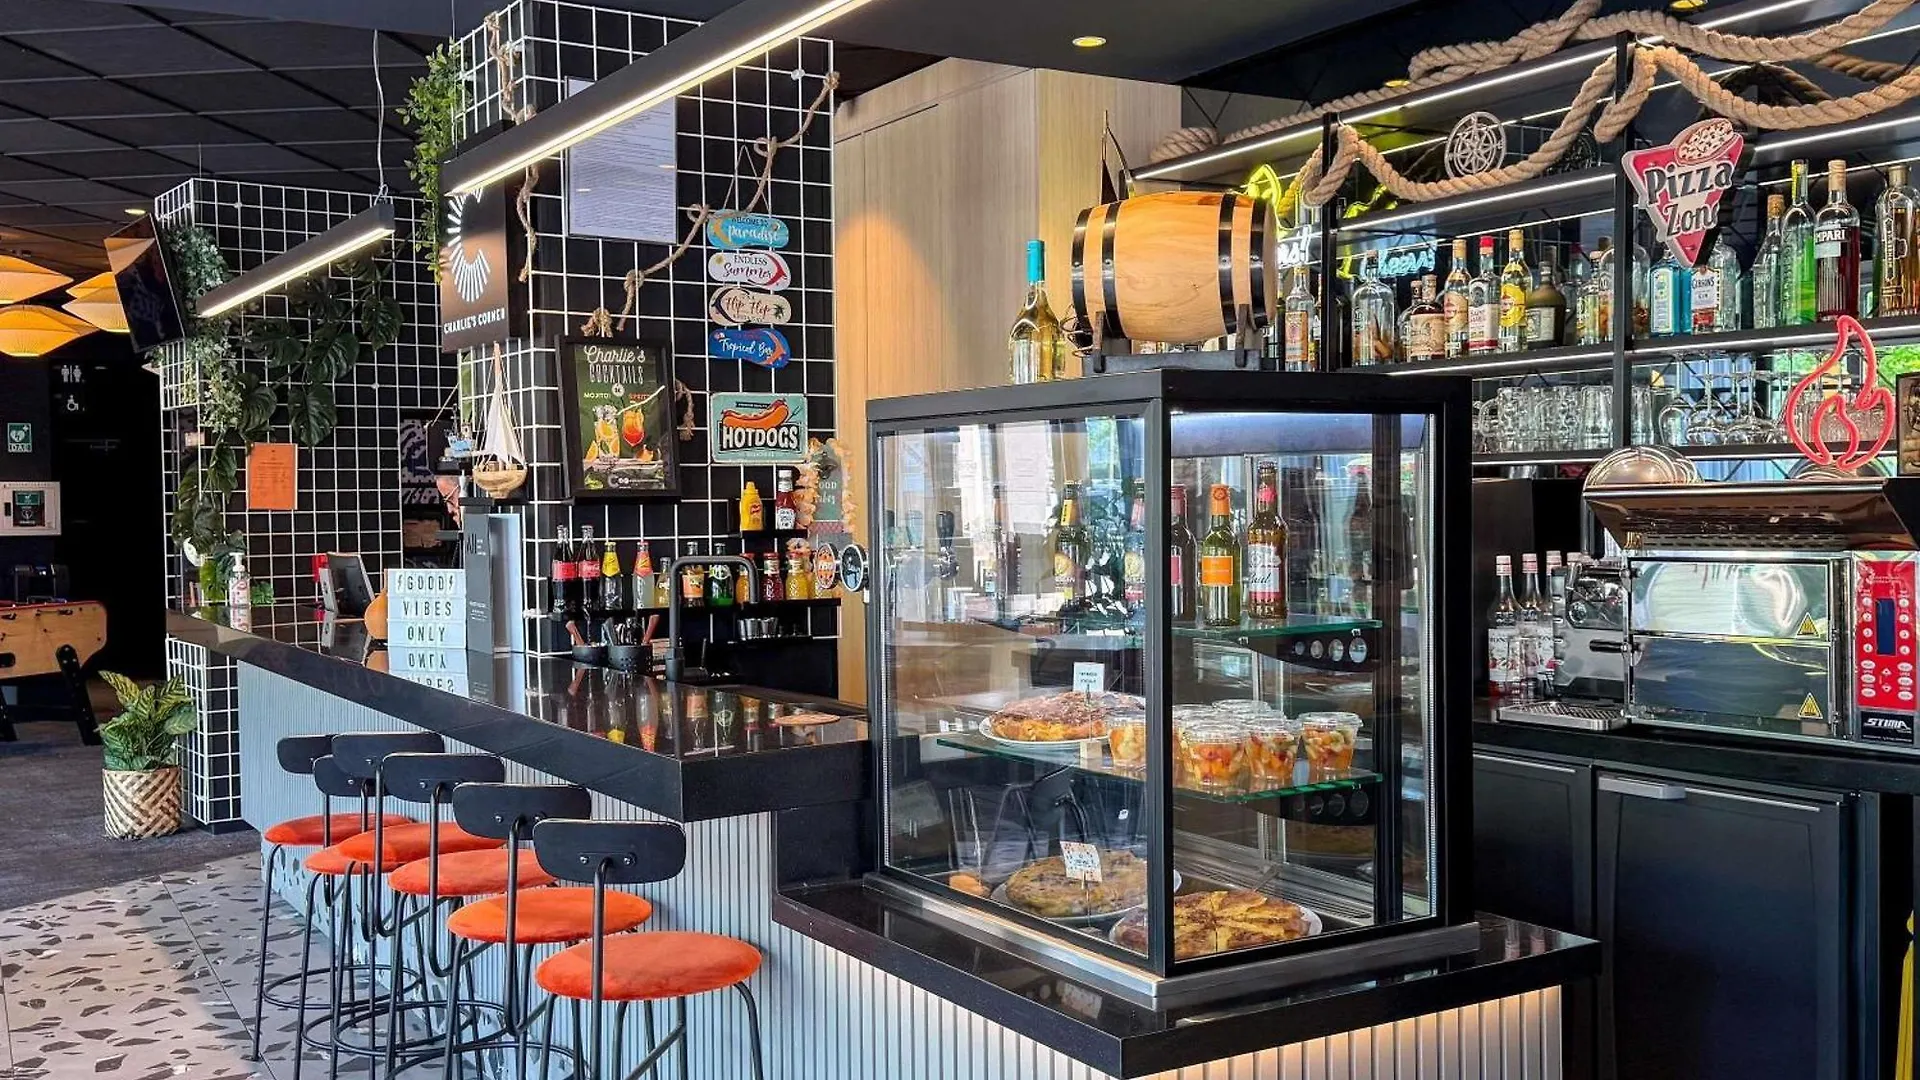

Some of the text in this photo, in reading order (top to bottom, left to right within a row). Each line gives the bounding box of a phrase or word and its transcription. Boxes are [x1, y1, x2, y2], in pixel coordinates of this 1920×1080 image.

[1644, 162, 1735, 203] Pizza
[734, 255, 768, 266] ENDLESS
[723, 262, 773, 279] Summer
[726, 295, 746, 315] Flip
[749, 300, 771, 318] Flop
[583, 345, 646, 364] Charlie's
[719, 338, 774, 359] Tropical Bar
[589, 364, 644, 385] COCKTAILS
[722, 426, 798, 450] HOTDOGS
[407, 576, 445, 591] GOOD
[403, 601, 452, 616] VIBES
[407, 626, 445, 642] ONLY
[1863, 717, 1911, 731] STIMA
